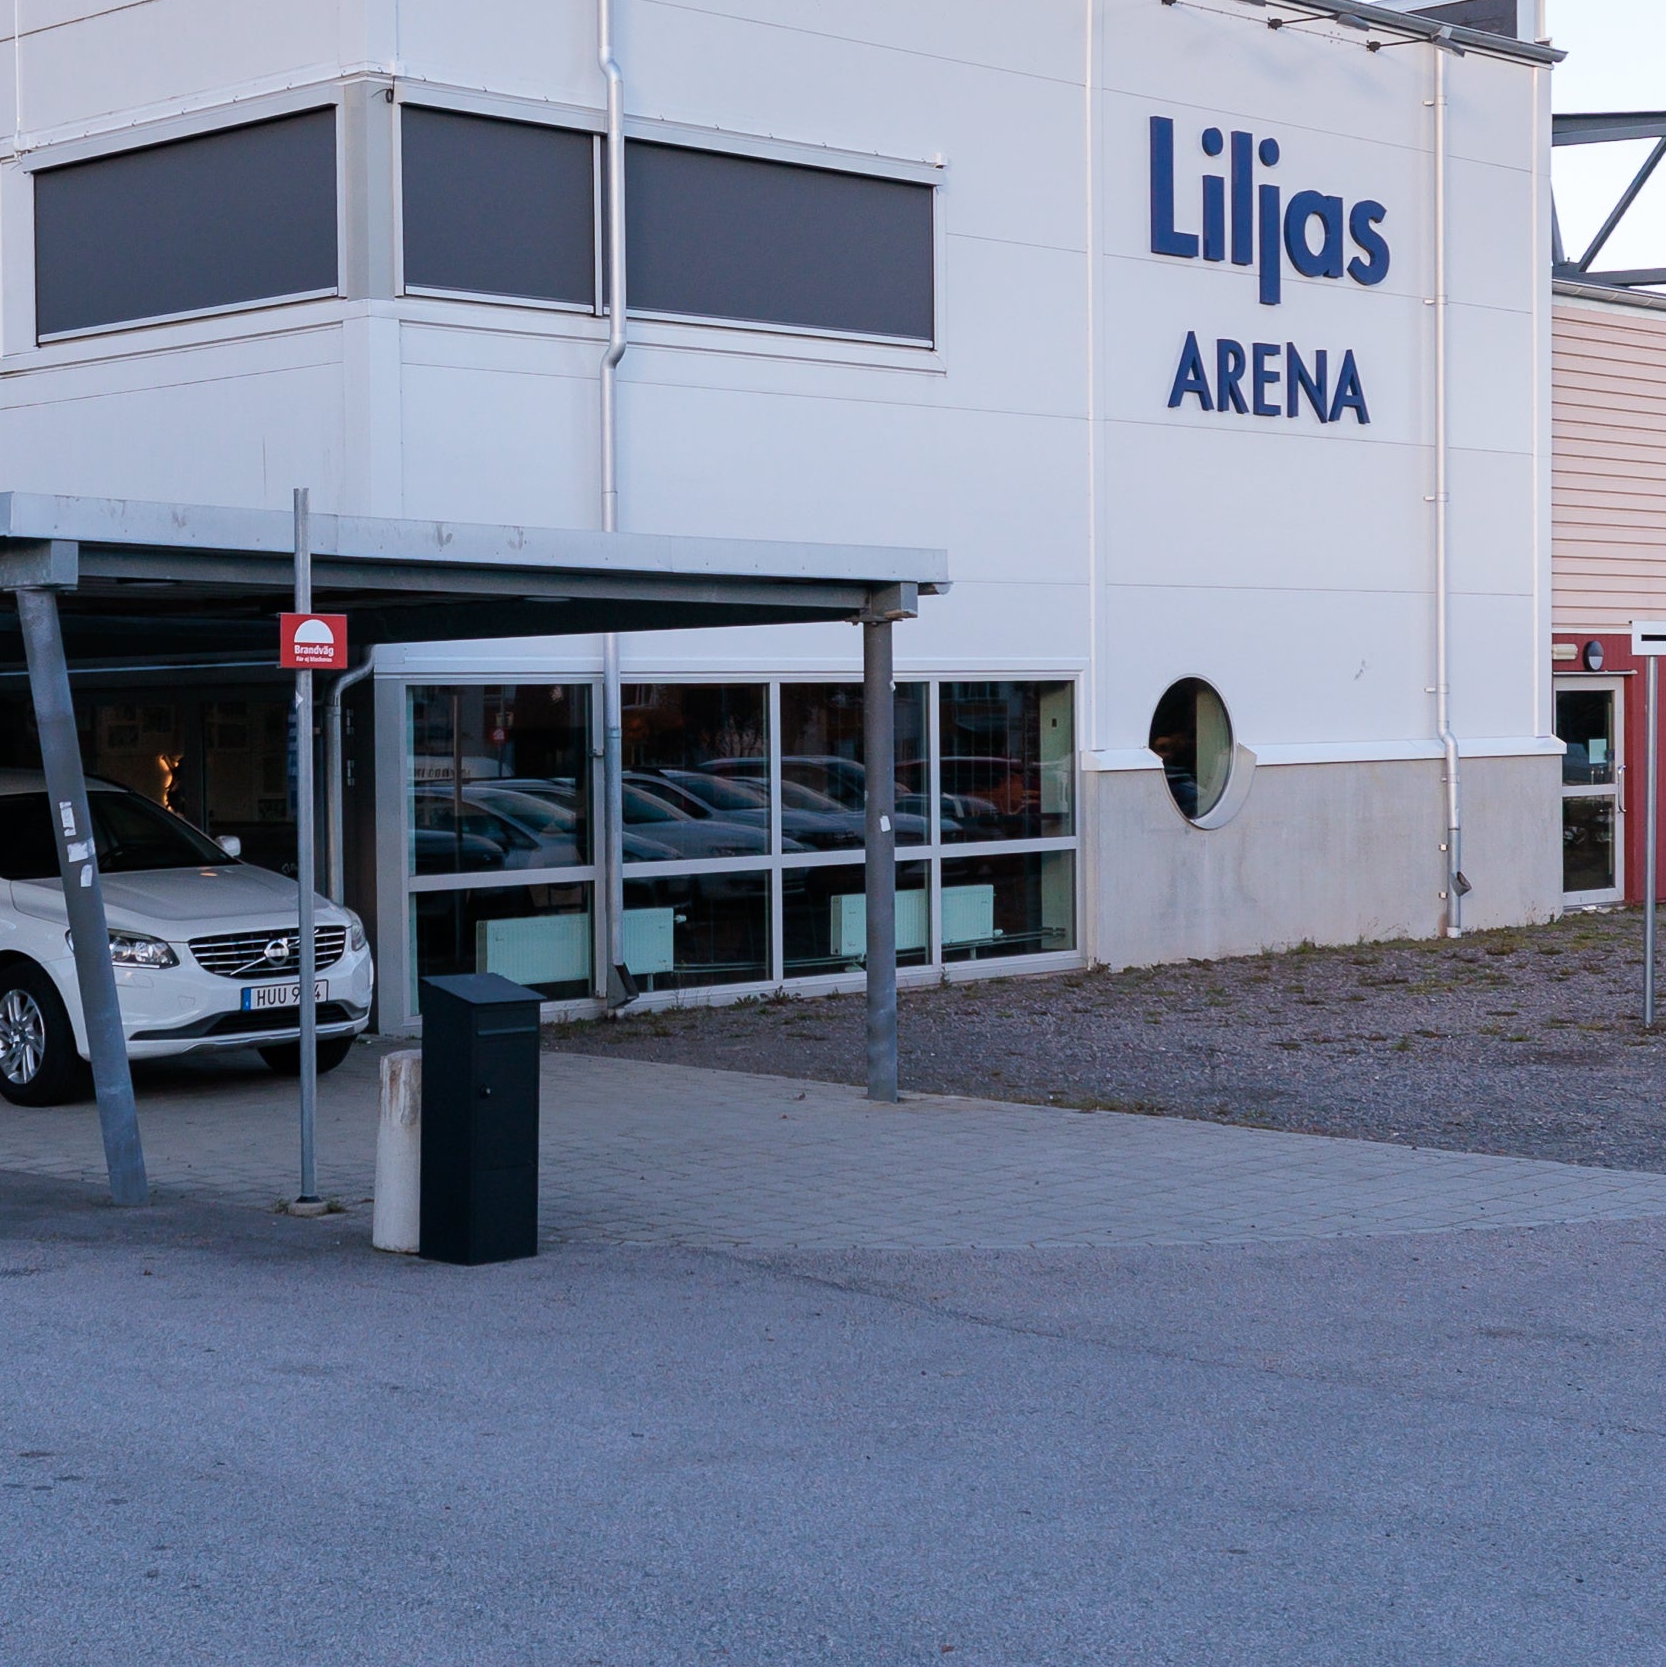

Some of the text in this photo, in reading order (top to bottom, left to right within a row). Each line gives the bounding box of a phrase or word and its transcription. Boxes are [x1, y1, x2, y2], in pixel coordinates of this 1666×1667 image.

[1149, 115, 1391, 306] Liljas
[1167, 330, 1371, 425] ARENA
[294, 644, 334, 657] Brandväg
[257, 983, 321, 1007] HUU 94
